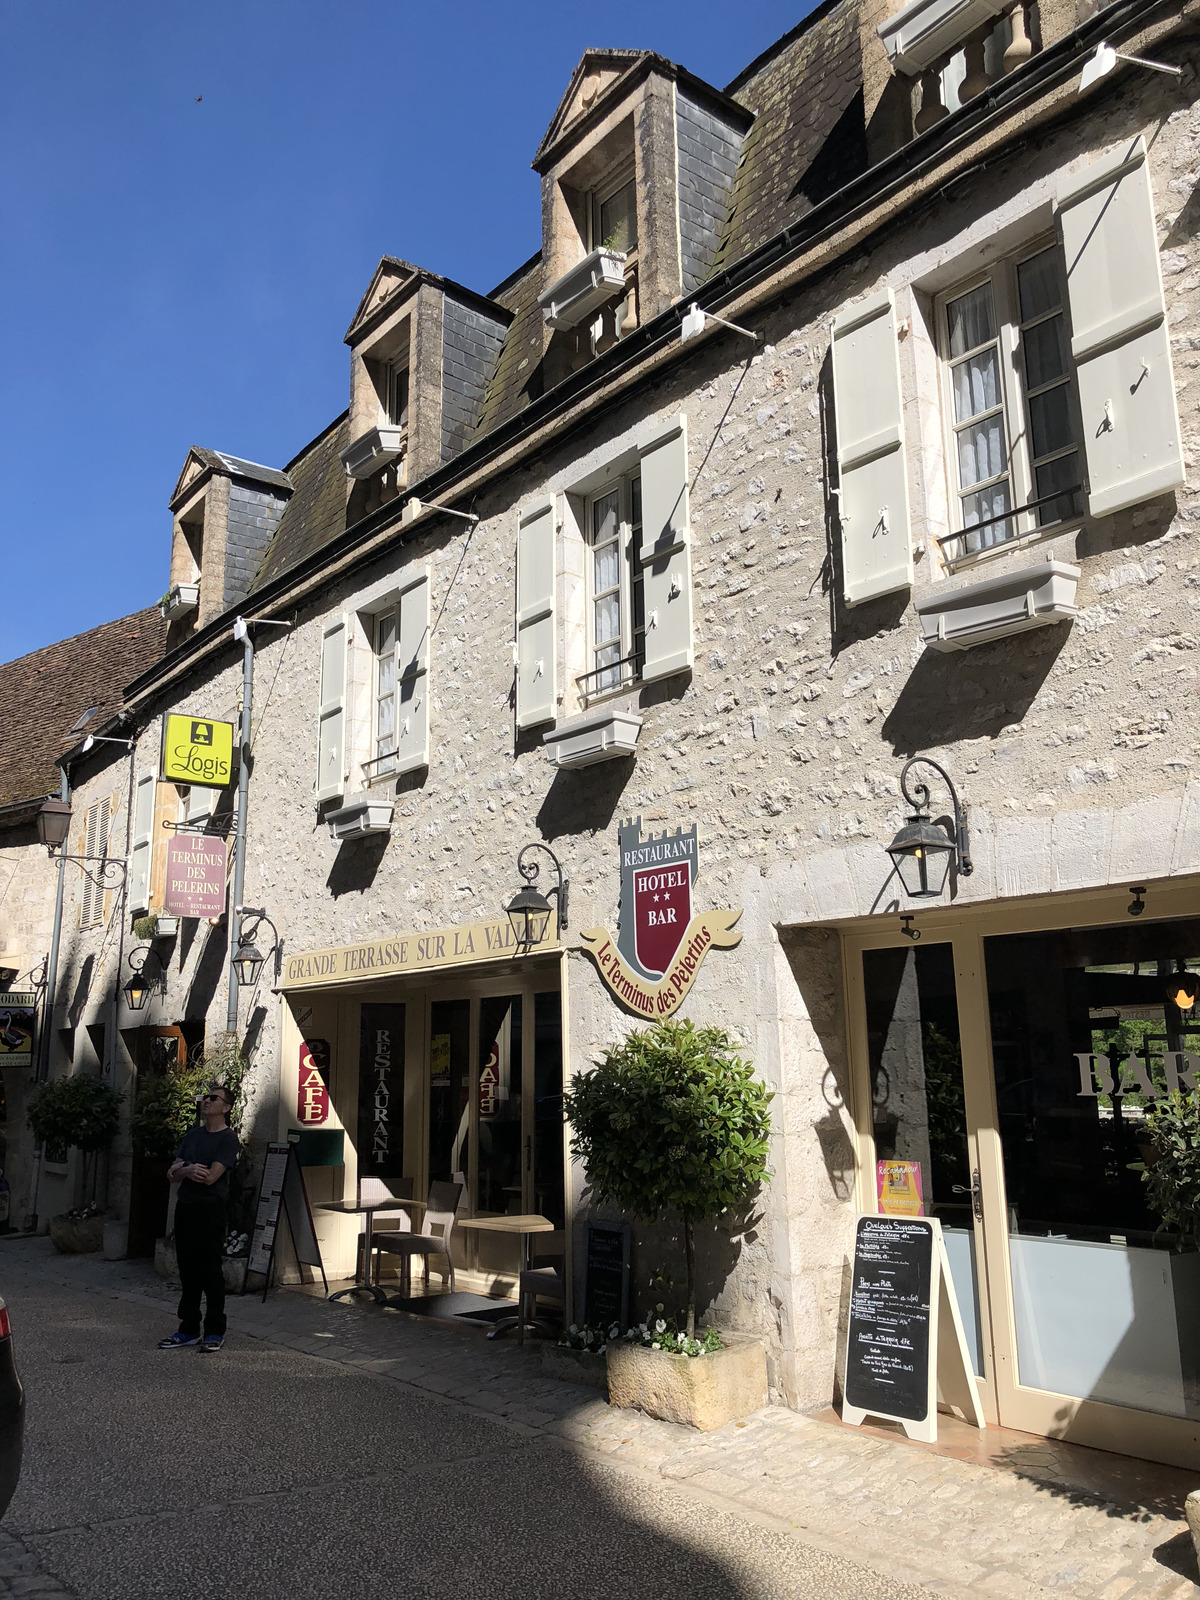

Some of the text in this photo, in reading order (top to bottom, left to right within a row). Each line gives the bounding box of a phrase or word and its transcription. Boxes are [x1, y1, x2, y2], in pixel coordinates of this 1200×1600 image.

[171, 745, 228, 780] Logis
[191, 838, 205, 851] LE
[624, 838, 695, 867] RESTAURANT
[172, 851, 223, 867] TERMINUS
[187, 867, 206, 880] DES
[637, 870, 687, 893] HOTEL
[172, 880, 220, 895] PELERINS
[648, 907, 677, 927] BAR
[289, 953, 338, 980] GRANDE
[343, 942, 409, 972] TERRASSE
[417, 935, 446, 961] SUR
[453, 930, 475, 956] LA
[597, 925, 711, 1014] Le Terminus des Pèlerins
[0, 994, 34, 1005] ODARD
[1073, 1049, 1200, 1097] BAR
[372, 1030, 391, 1163] RESTAURANT
[879, 1166, 918, 1176] Rocamadour
